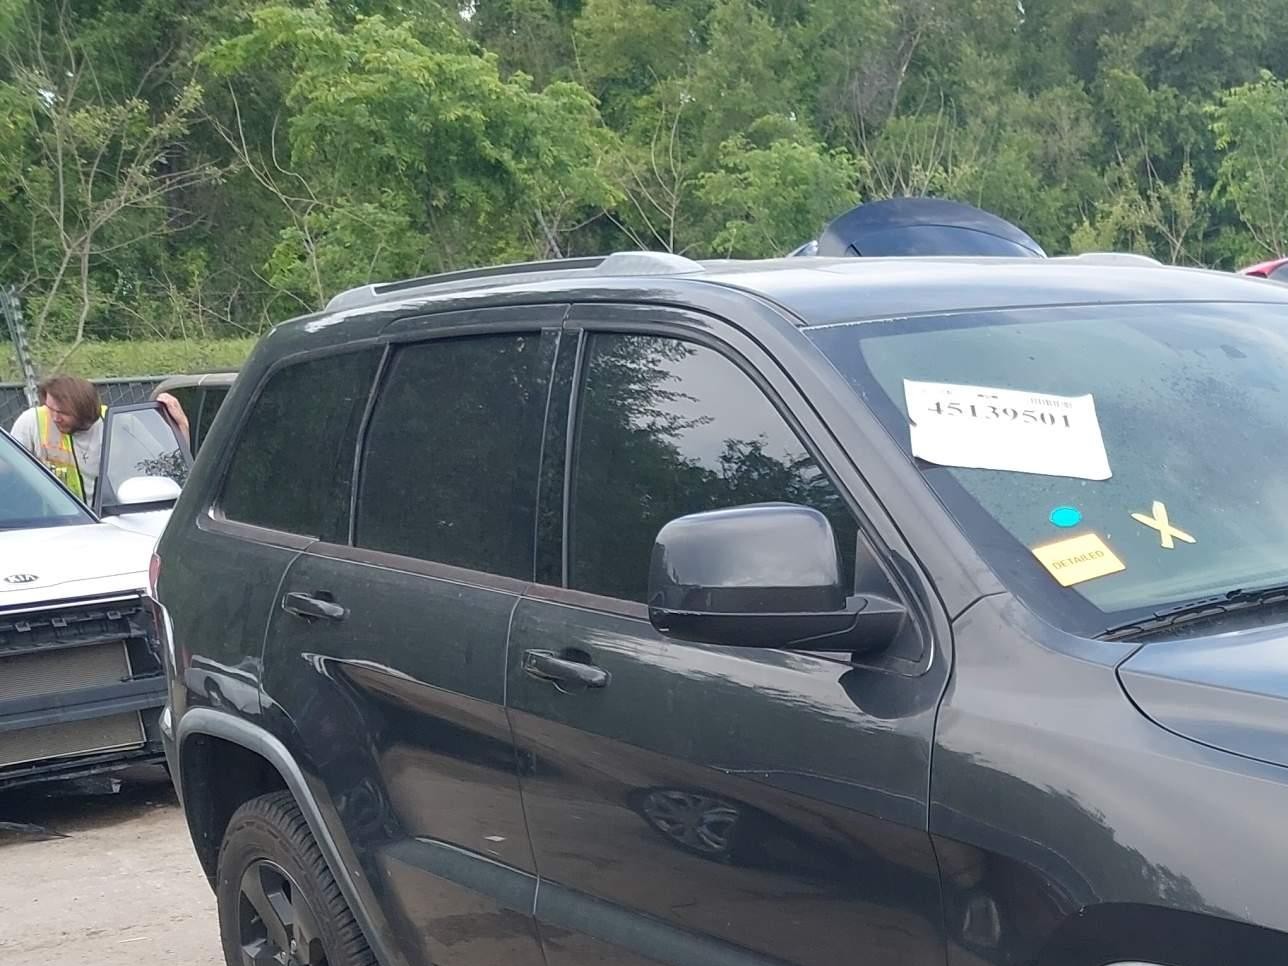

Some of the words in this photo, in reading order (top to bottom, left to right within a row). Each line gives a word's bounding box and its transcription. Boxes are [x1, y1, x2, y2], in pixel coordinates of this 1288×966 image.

[927, 401, 1070, 428] 45139501
[1051, 550, 1105, 570] DETAILED
[8, 574, 35, 583] KIA
